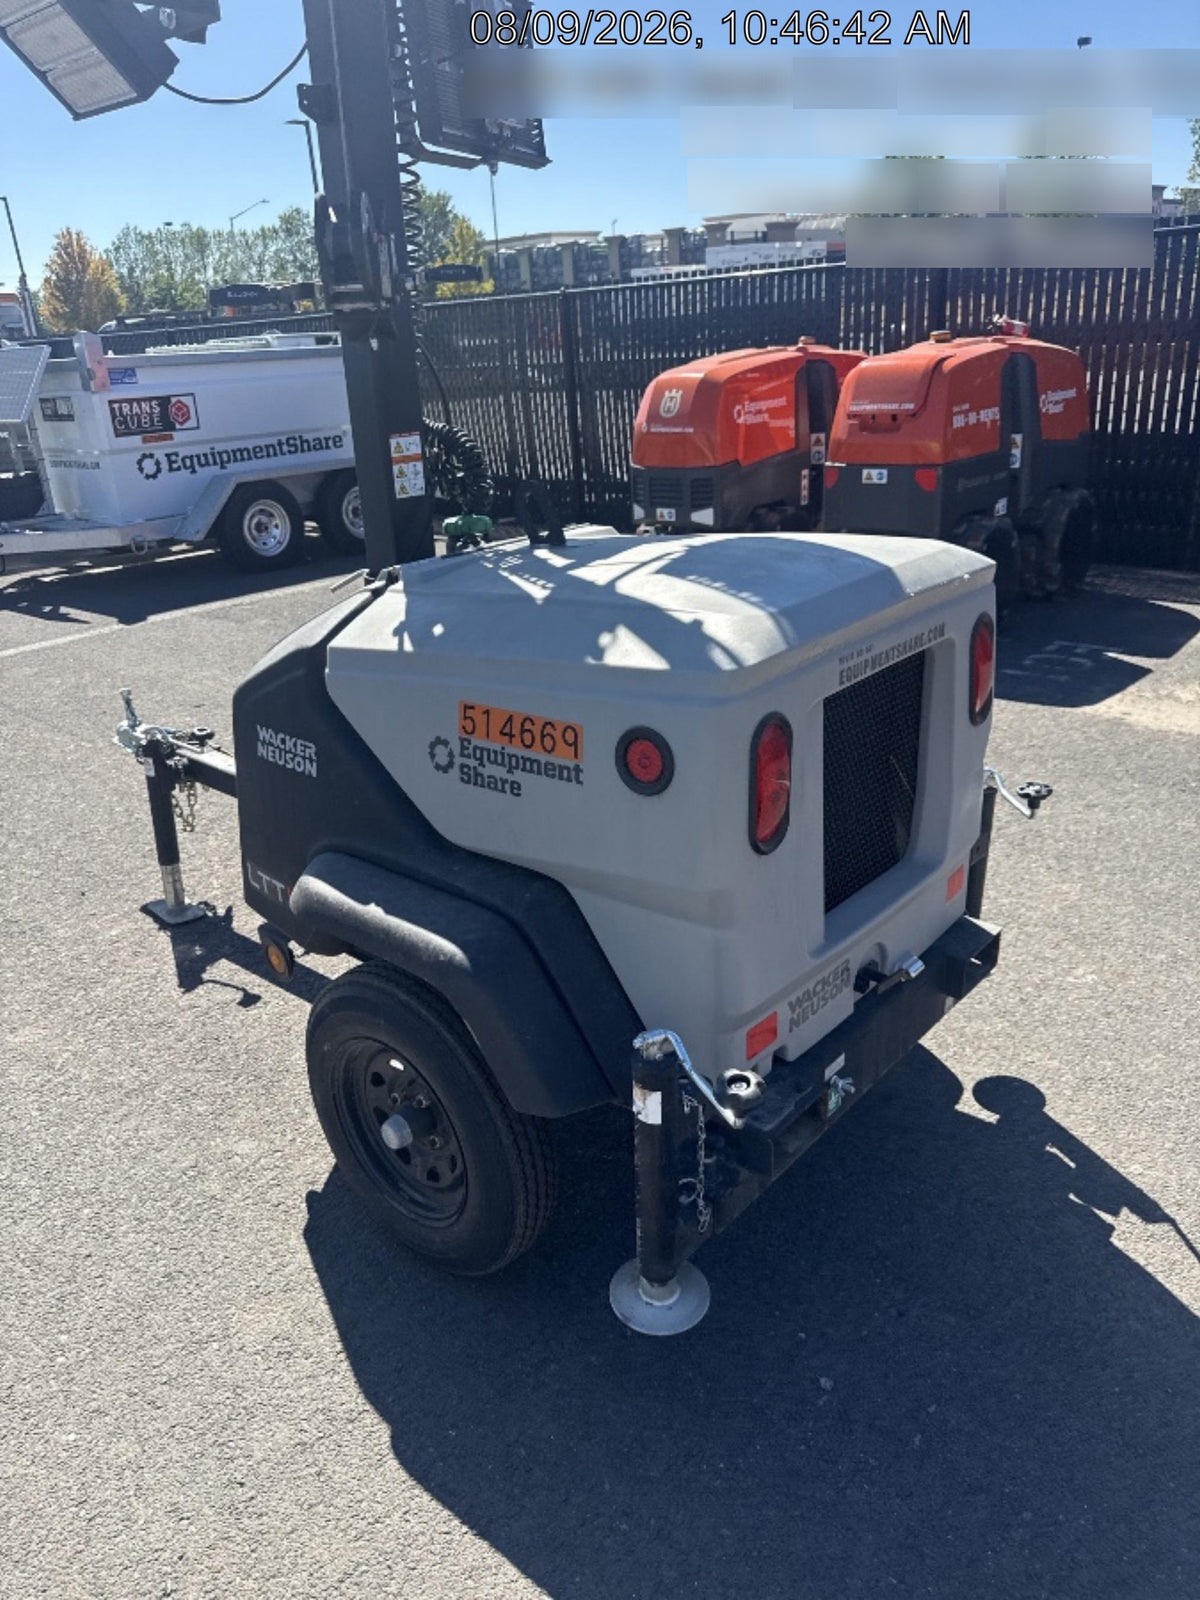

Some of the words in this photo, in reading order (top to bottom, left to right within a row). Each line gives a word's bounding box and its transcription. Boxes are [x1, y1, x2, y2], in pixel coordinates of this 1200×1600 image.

[112, 400, 161, 417] TRANS
[114, 414, 163, 430] CUBE
[168, 433, 344, 475] EquipmentShare
[838, 622, 946, 686] EQUIPMENTSHARE.COM
[256, 724, 317, 759] WACKER
[461, 704, 580, 760] 514669
[256, 745, 318, 778] NEUSON
[458, 736, 584, 786] Equipment
[459, 764, 522, 797] Share
[246, 861, 292, 903] LTT
[787, 959, 851, 1014] WACKER
[788, 977, 851, 1032] NEUSON
